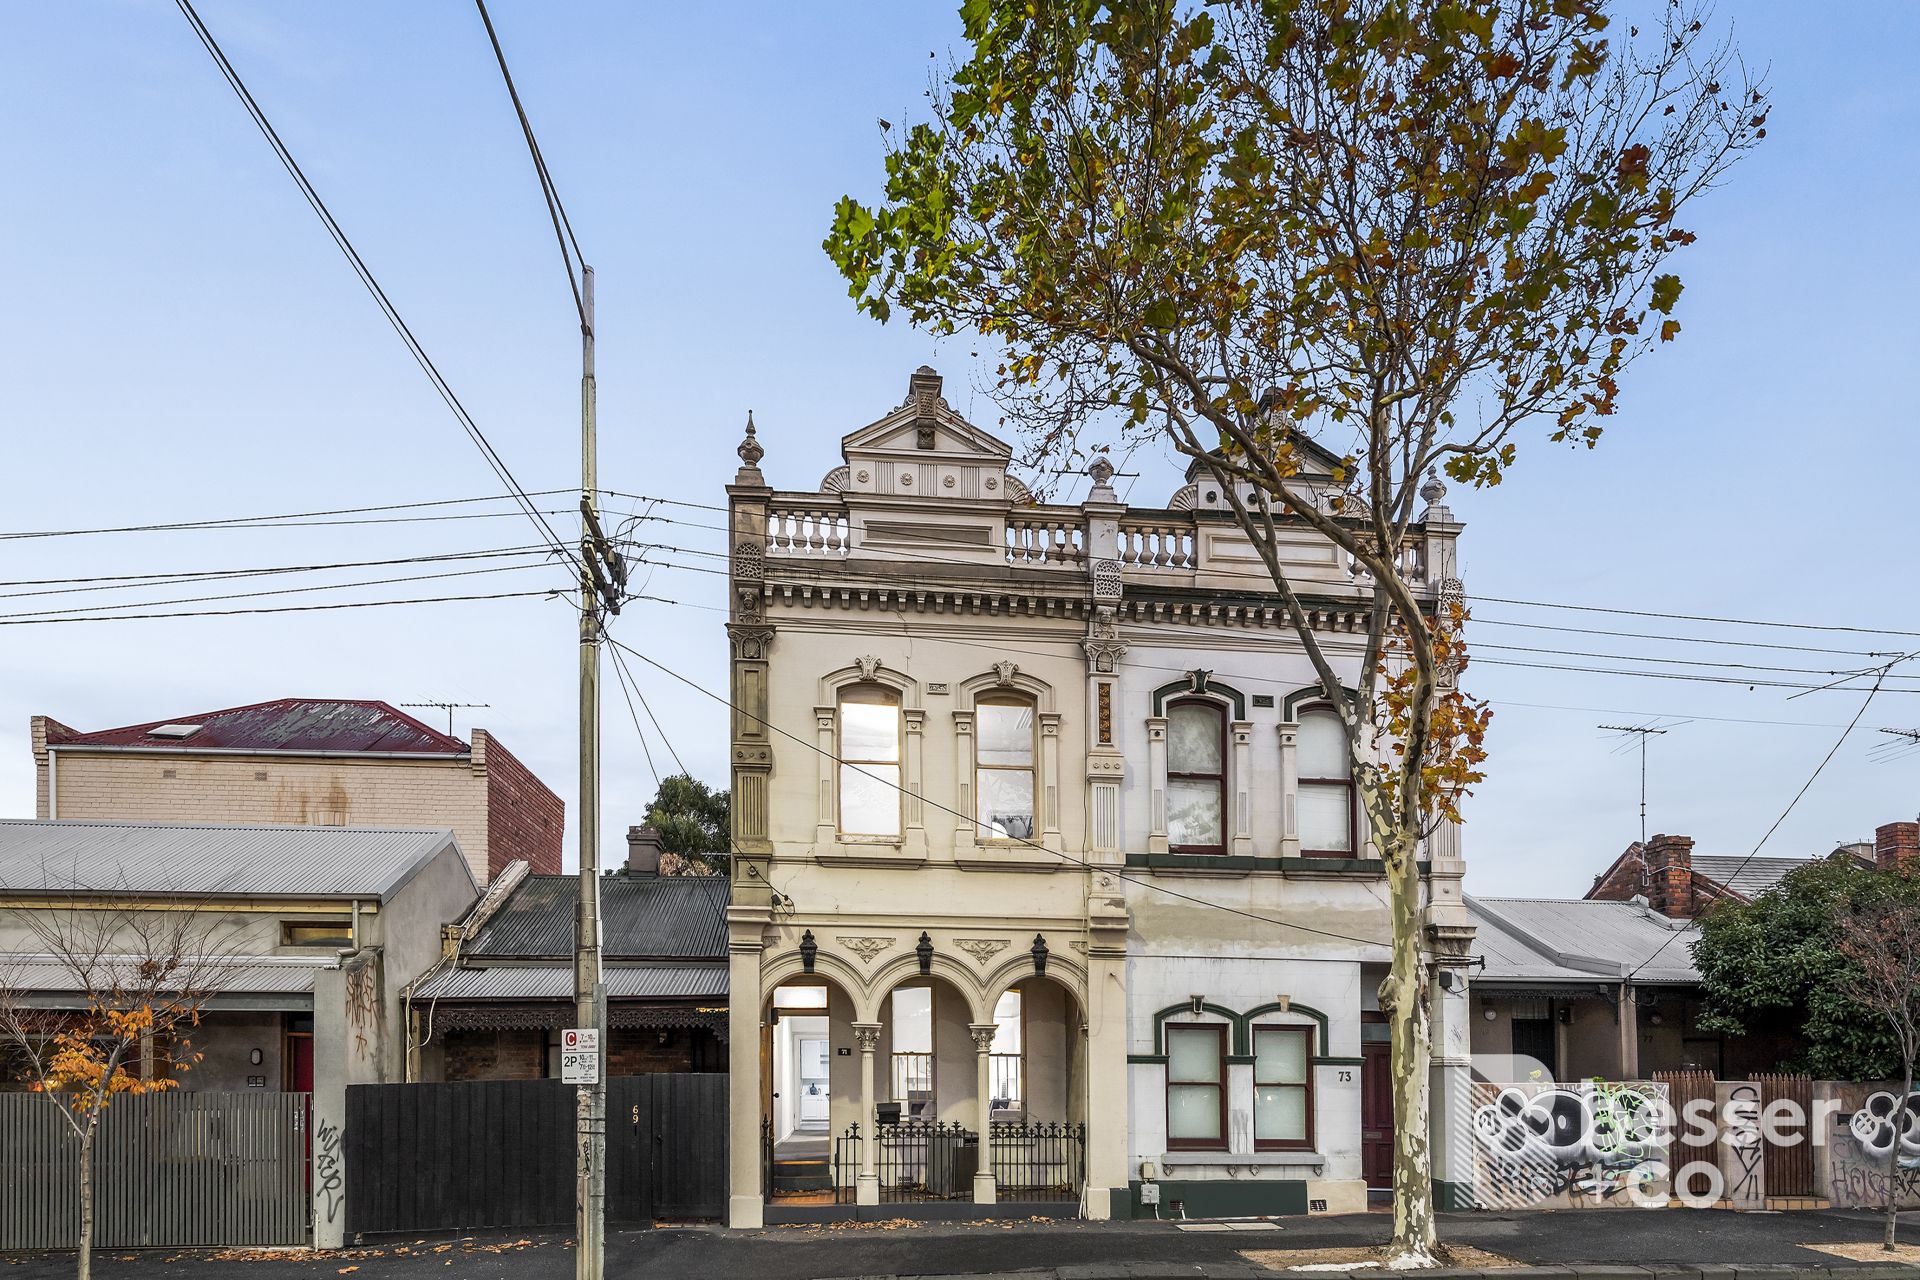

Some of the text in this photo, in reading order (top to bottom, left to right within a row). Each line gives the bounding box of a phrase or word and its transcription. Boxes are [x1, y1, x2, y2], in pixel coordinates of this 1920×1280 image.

[567, 1032, 576, 1046] C
[564, 1056, 577, 1067] 2P
[1338, 1071, 1352, 1082] 73
[632, 1104, 639, 1124] 69
